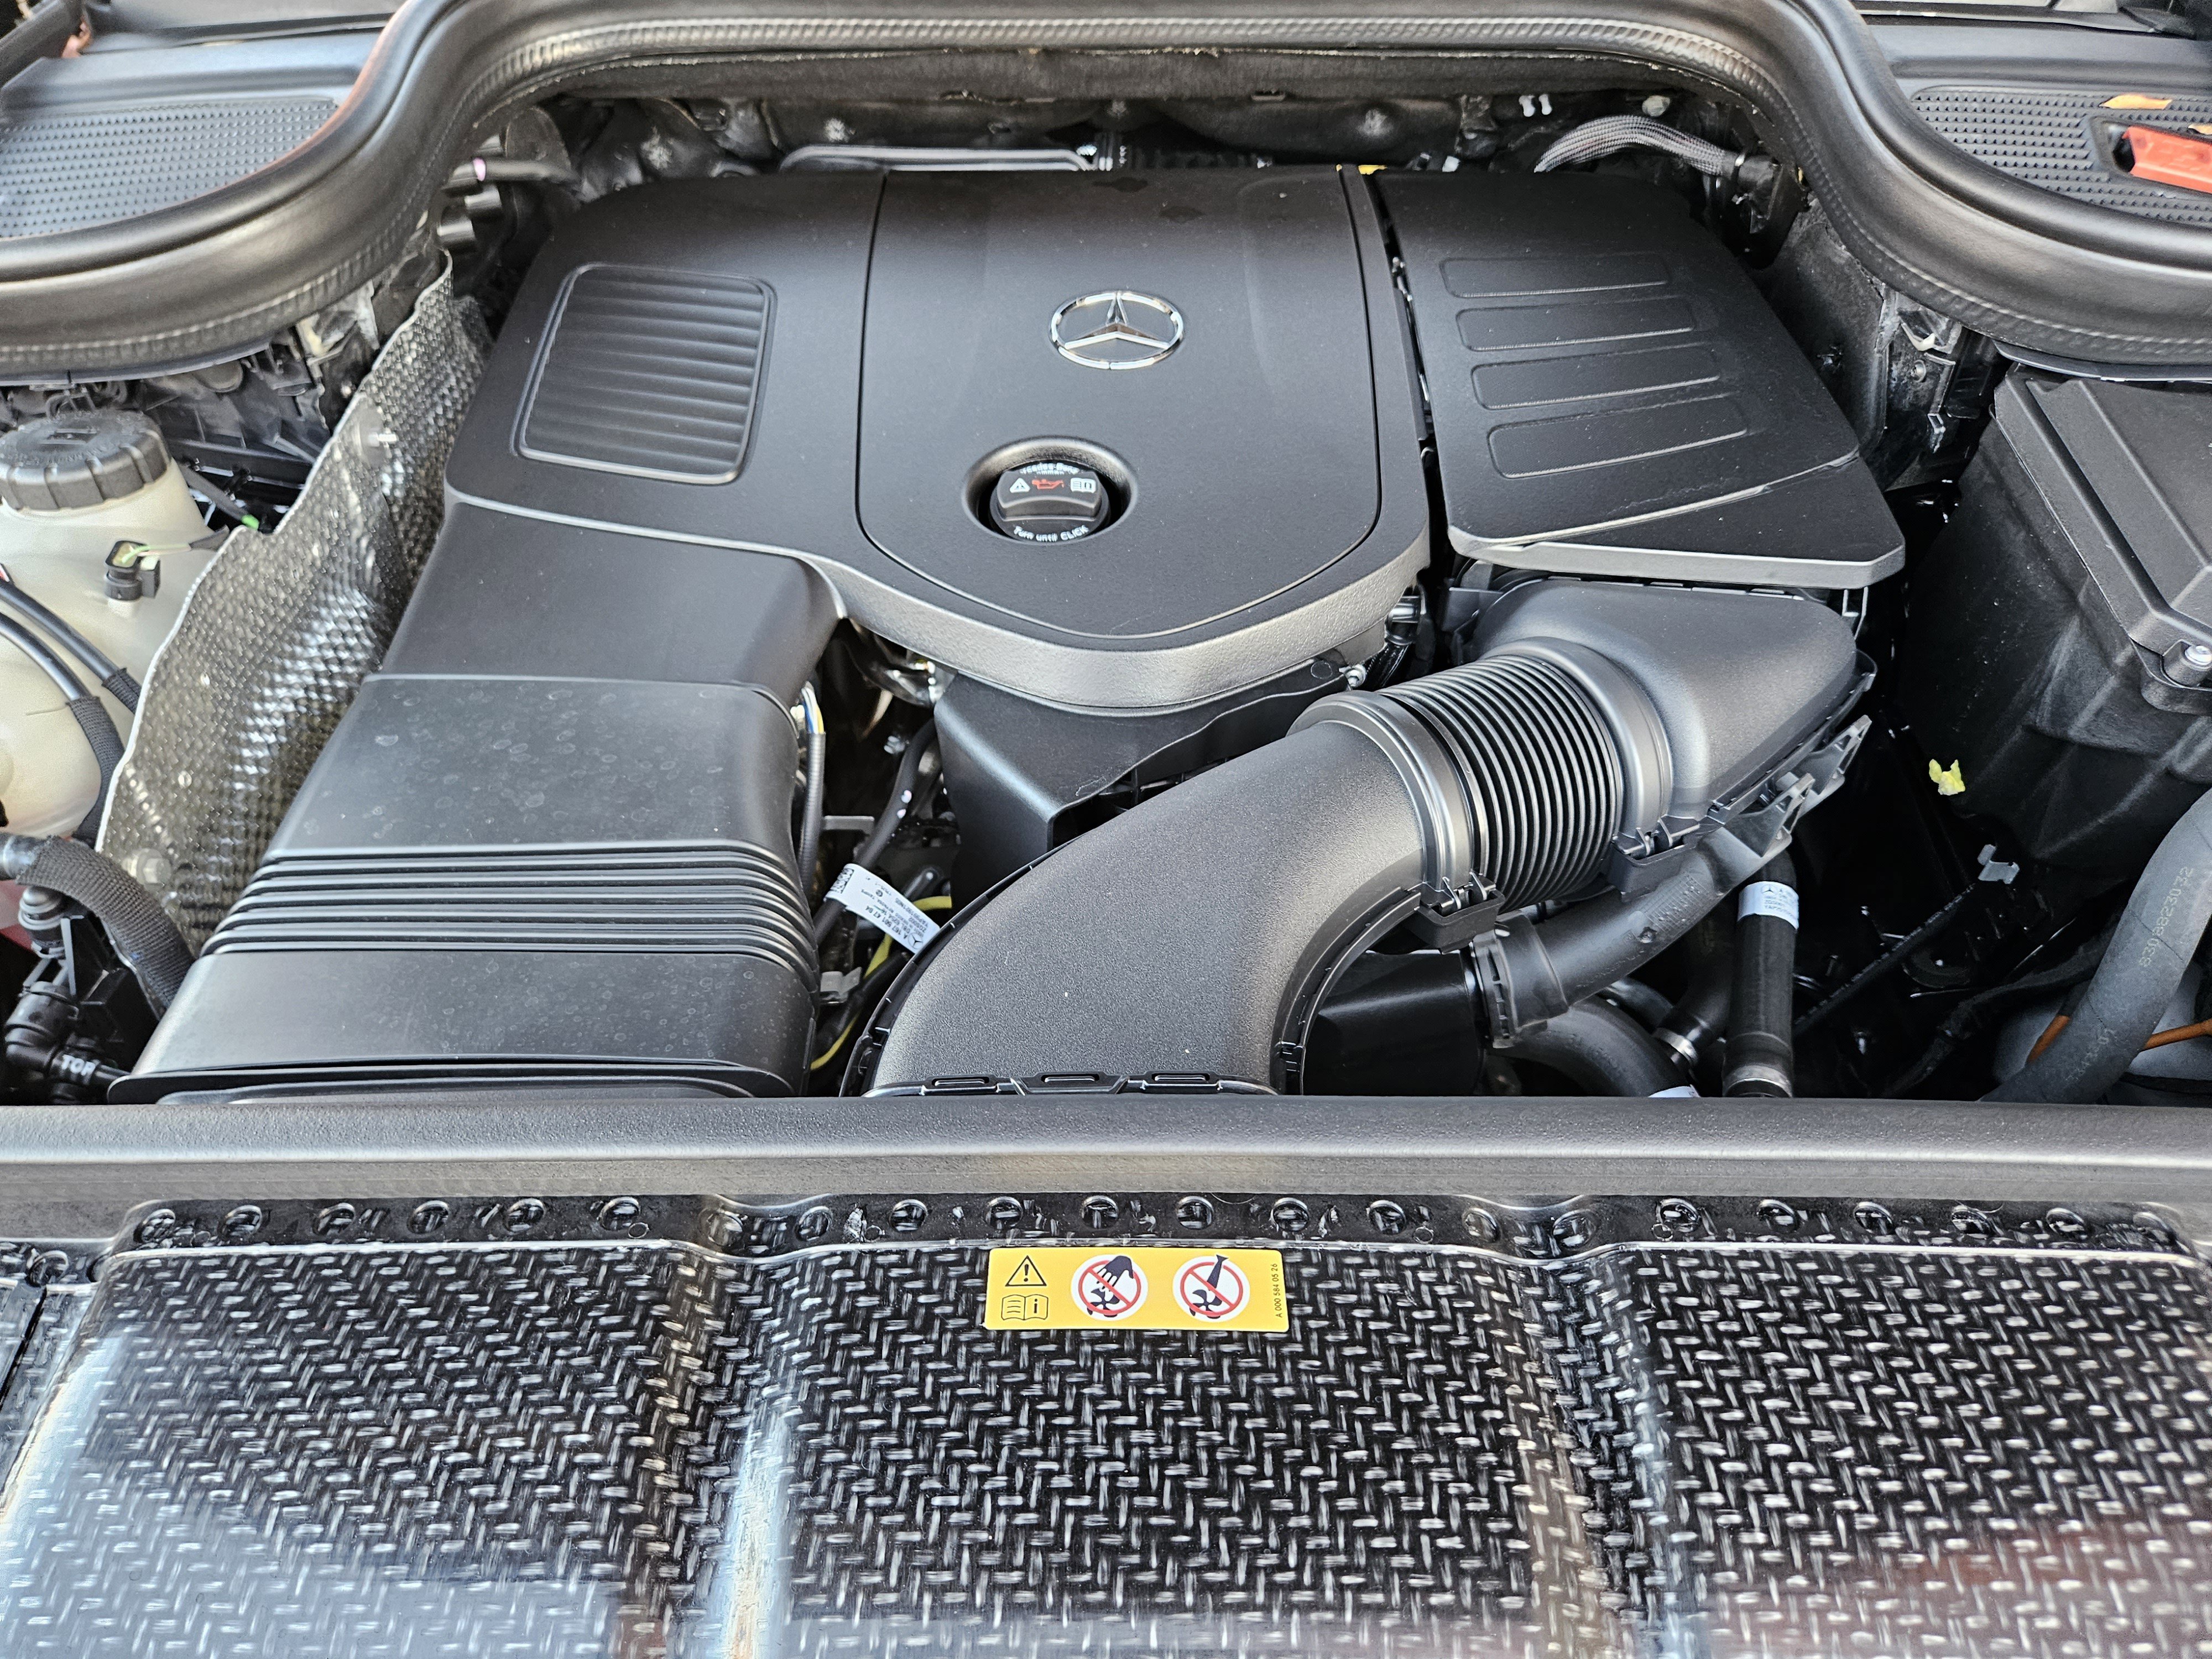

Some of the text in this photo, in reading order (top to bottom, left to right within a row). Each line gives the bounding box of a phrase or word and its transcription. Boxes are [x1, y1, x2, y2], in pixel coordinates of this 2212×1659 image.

[1013, 525, 1089, 542] Turn until CLICK
[892, 925, 901, 935] 167
[61, 1054, 96, 1076] TOP
[1271, 1274, 1279, 1282] 05
[1272, 1284, 1281, 1296] 584
[1274, 1298, 1282, 1311] 000
